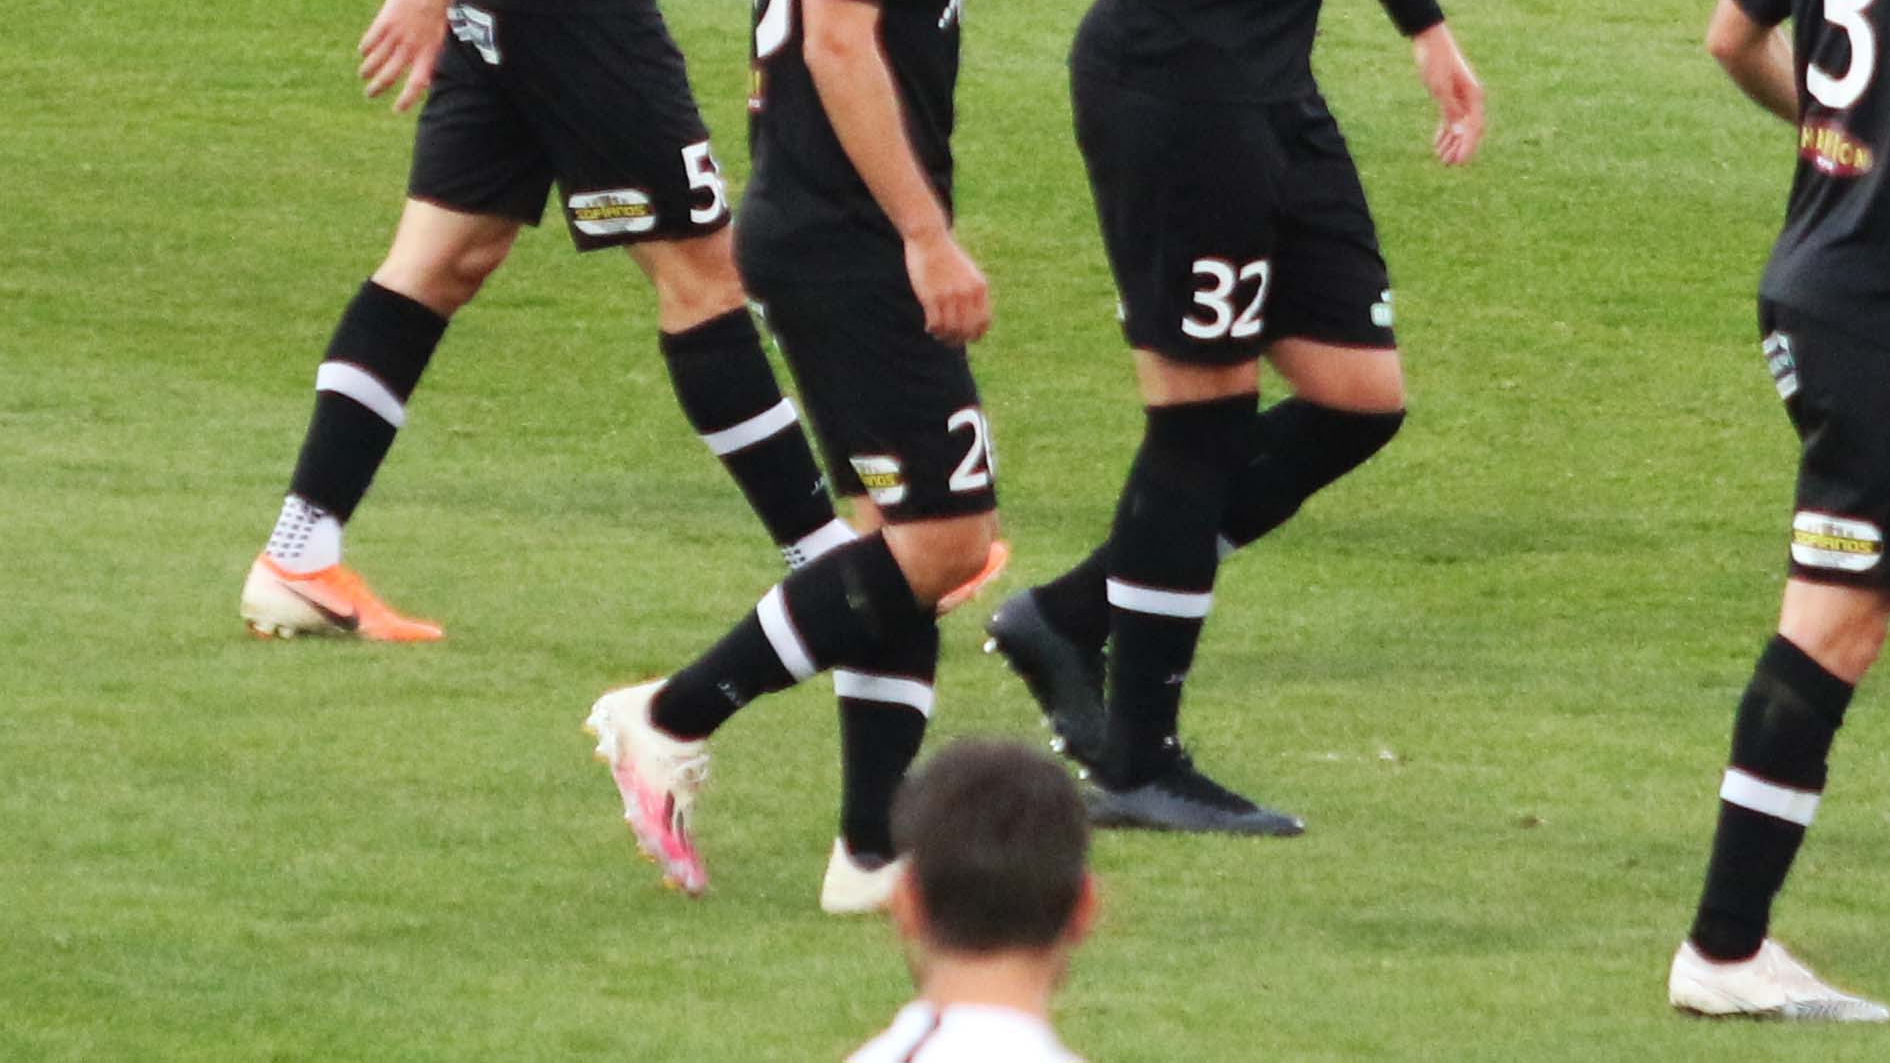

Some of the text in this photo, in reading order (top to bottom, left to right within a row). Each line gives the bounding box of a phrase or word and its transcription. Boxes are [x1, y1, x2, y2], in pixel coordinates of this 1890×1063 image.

[681, 140, 729, 224] 5
[1181, 258, 1271, 339] 32
[947, 407, 995, 492] 2
